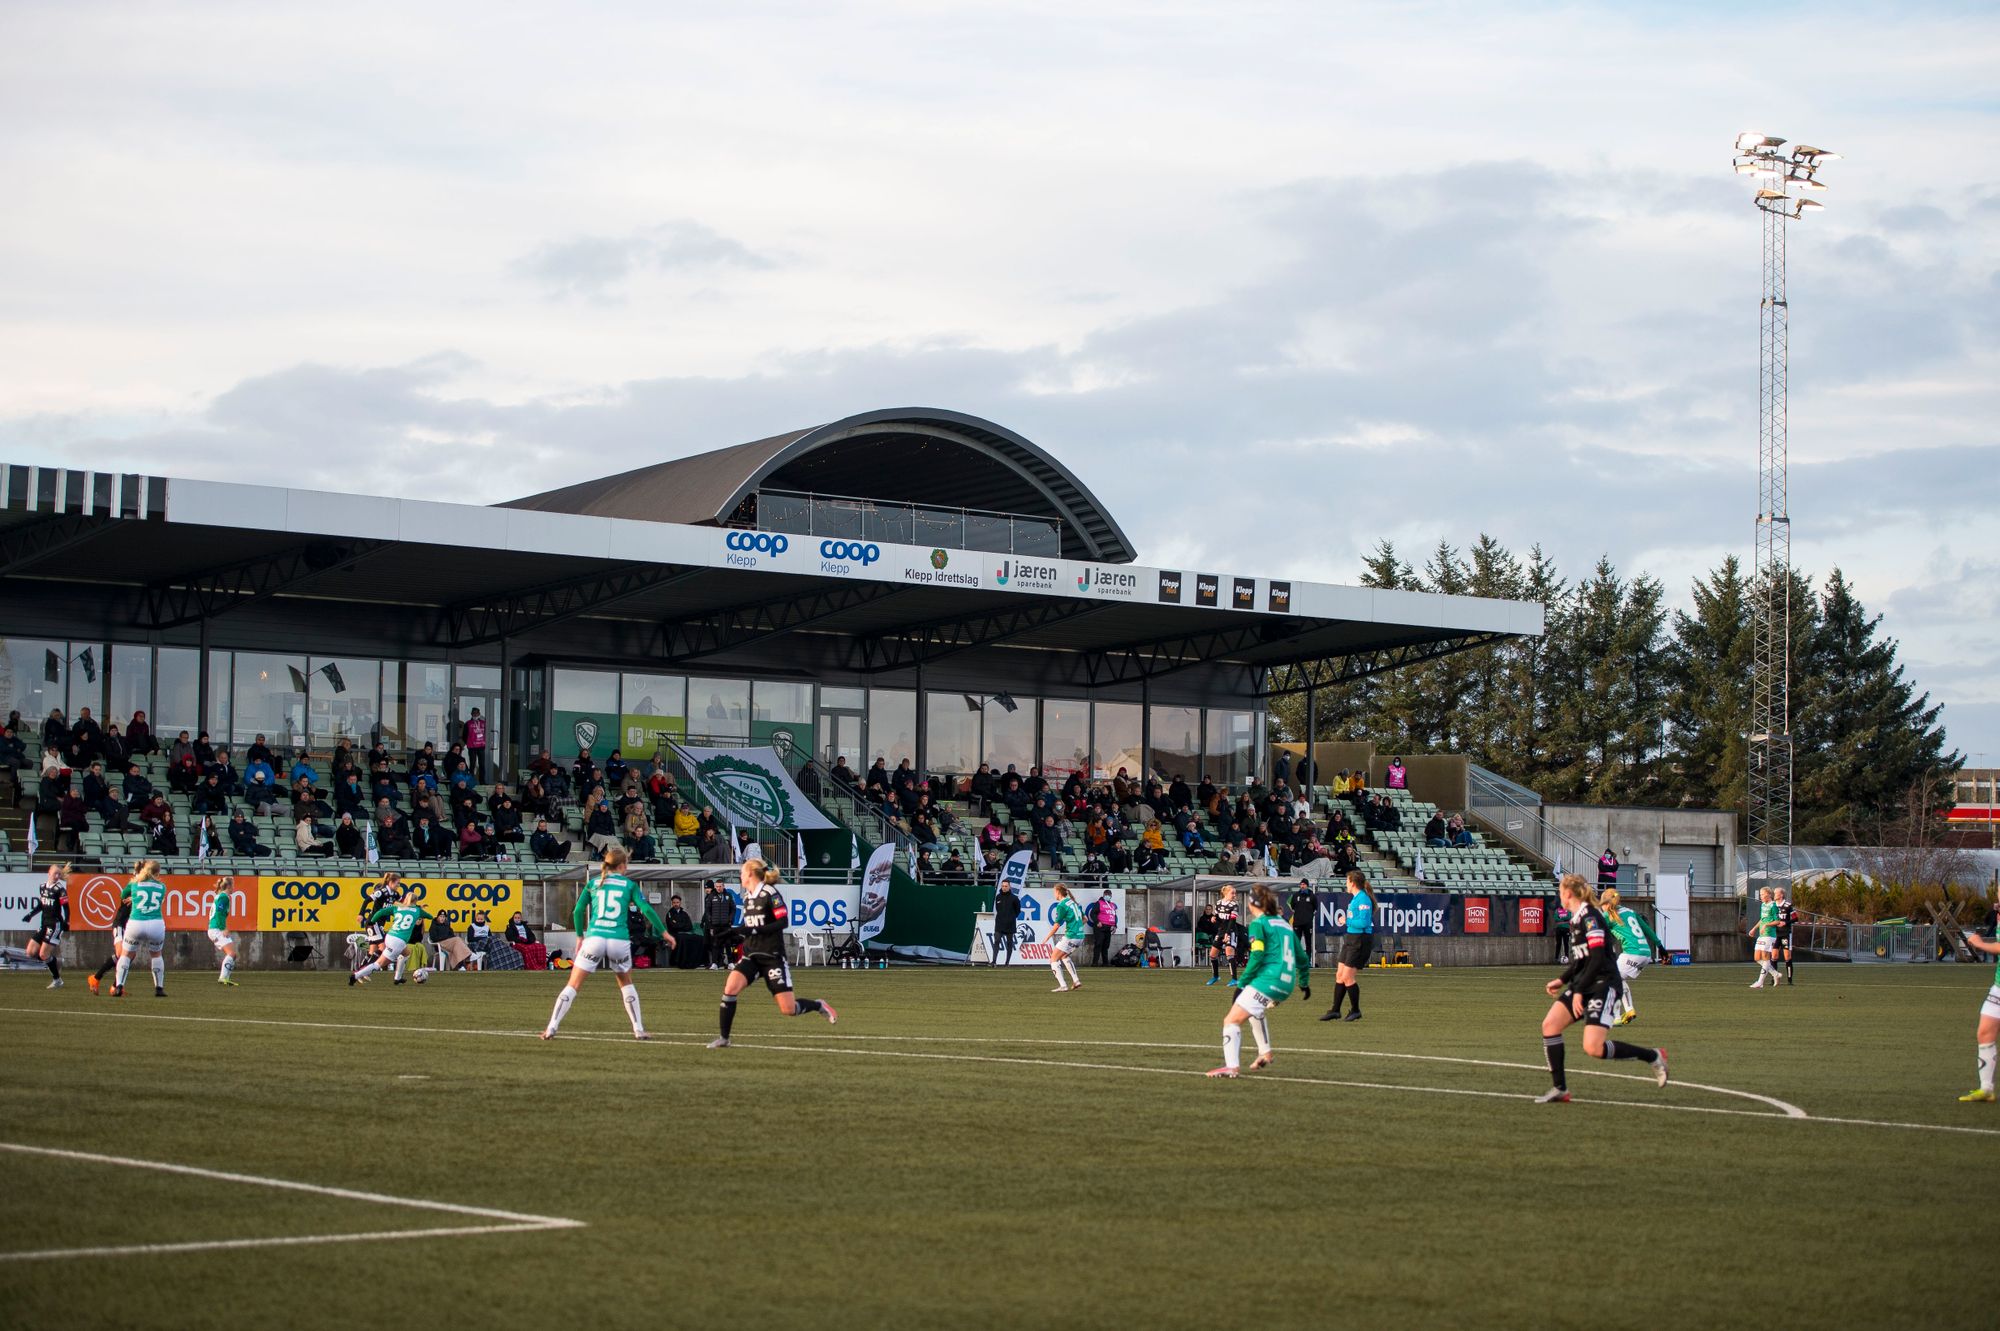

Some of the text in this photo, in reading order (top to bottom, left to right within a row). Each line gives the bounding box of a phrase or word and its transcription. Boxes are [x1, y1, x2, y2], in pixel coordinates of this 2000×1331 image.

[726, 532, 789, 557] coop
[820, 540, 880, 566] coop
[727, 553, 757, 568] Klepp
[821, 561, 850, 575] Klepp
[1014, 560, 1057, 580] jæren
[905, 568, 979, 587] Klepp Idrettslag
[1017, 580, 1053, 589] sparebank
[1094, 568, 1136, 587] jæren
[1162, 579, 1179, 589] Klepp
[1199, 582, 1216, 592] Klepp
[1097, 587, 1132, 596] sparebank
[1236, 586, 1253, 596] Klepp
[1272, 589, 1289, 599] Klepp
[740, 781, 760, 794] 1919
[136, 890, 161, 910] 25
[272, 881, 340, 905] coop
[446, 884, 510, 906] coop
[596, 890, 623, 919] 15
[791, 900, 847, 926] BOS
[1466, 907, 1487, 917] THON
[1520, 907, 1542, 917] THON
[272, 901, 320, 928] prix
[393, 912, 413, 931] 28
[1379, 902, 1444, 933] Tipping
[1627, 916, 1643, 938] 8
[1284, 935, 1294, 971] 4
